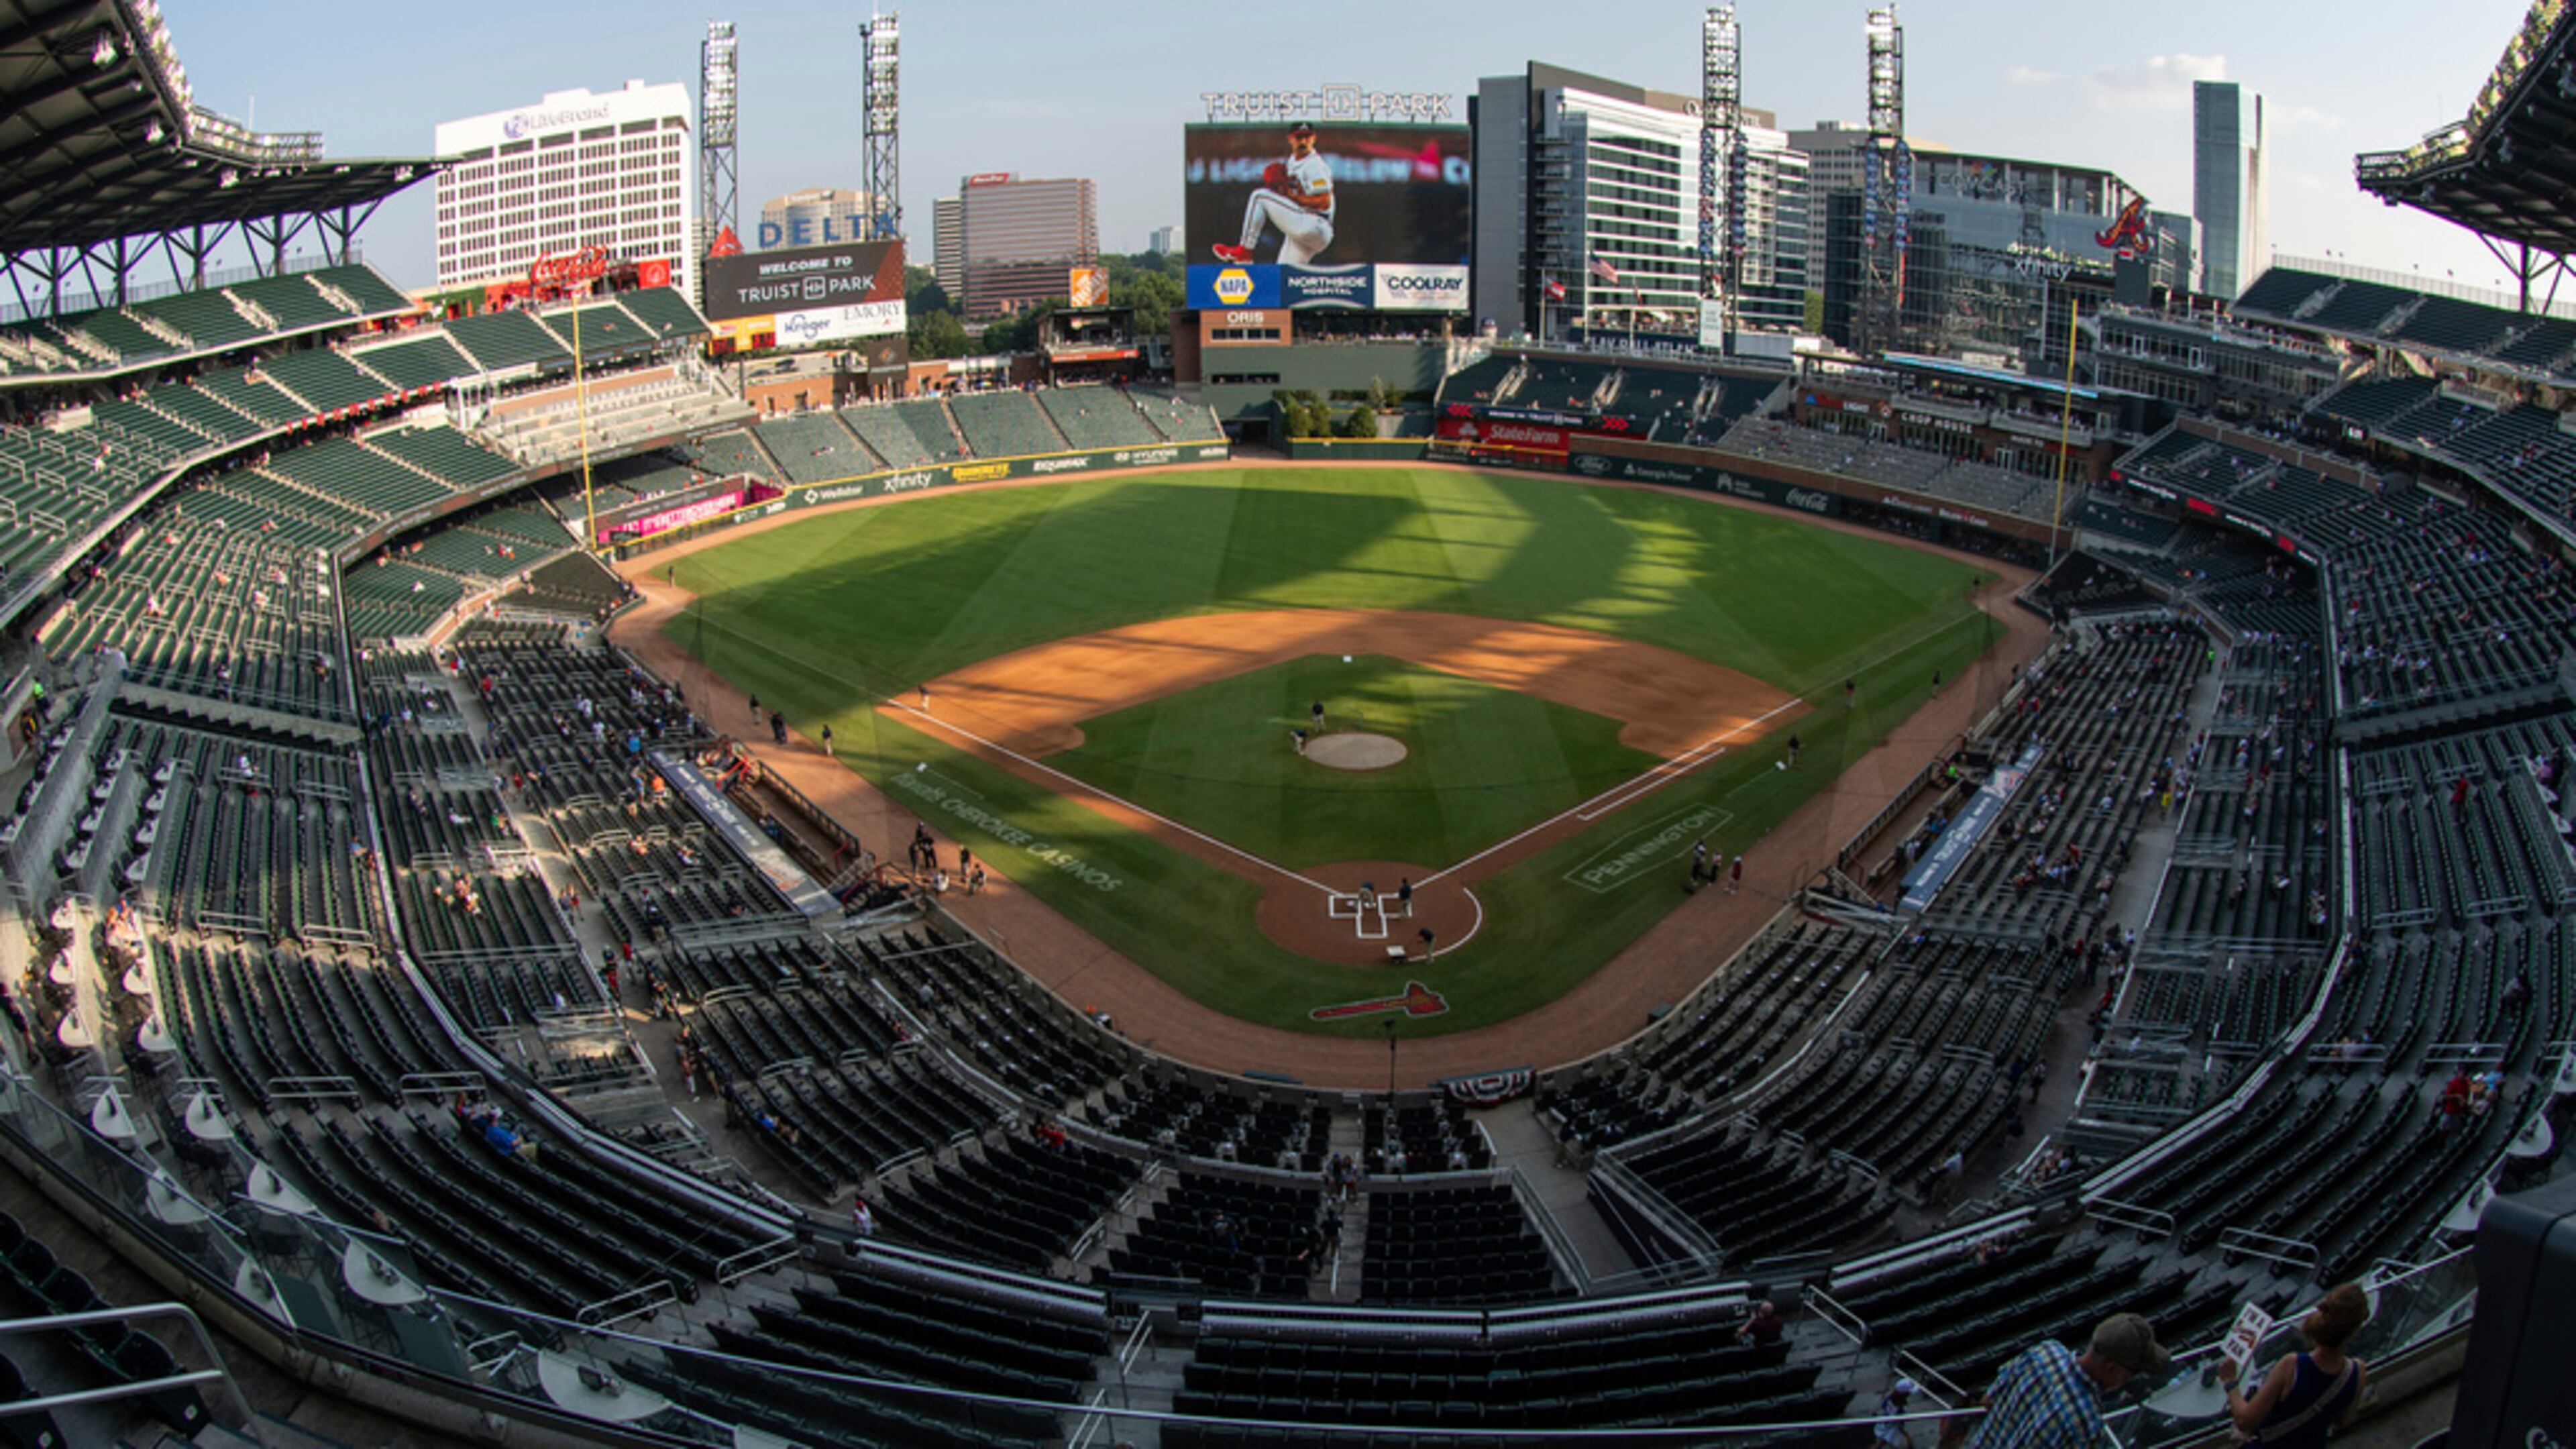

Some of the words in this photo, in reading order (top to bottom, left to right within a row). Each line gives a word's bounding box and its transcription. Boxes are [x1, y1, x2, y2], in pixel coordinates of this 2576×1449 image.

[1200, 92, 1316, 116] TRUIST
[1369, 92, 1452, 117] PARK
[758, 211, 897, 250] DELTA
[759, 258, 830, 275] WELCOME
[834, 256, 853, 268] TO
[2015, 256, 2072, 282] xfinity
[737, 282, 800, 303] TRUIST
[829, 274, 877, 294] PARK
[1219, 278, 1248, 294] NAPA
[1288, 276, 1367, 288] NORTHSIDE
[1302, 287, 1354, 296] HOSPITAL
[1387, 275, 1463, 290] COOLRAY
[843, 302, 900, 321] EMORY
[1226, 311, 1265, 323] ORIS
[784, 314, 831, 339] Kroger
[883, 472, 932, 493] xfinity
[941, 798, 1032, 845] CHEROKEE
[1026, 841, 1124, 892] CASINOS
[1582, 809, 1718, 884] PENNINGTON
